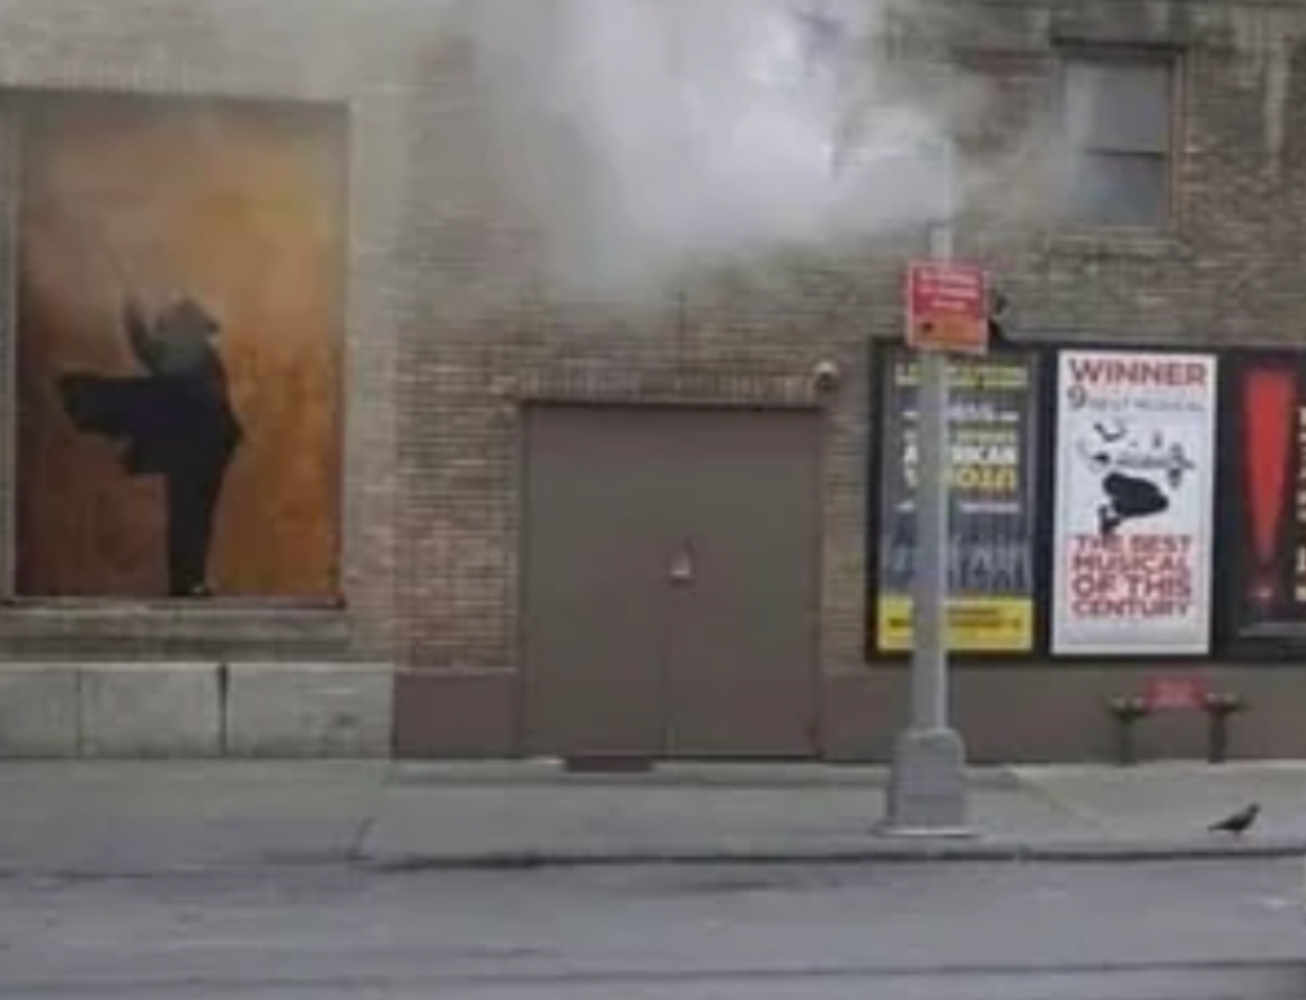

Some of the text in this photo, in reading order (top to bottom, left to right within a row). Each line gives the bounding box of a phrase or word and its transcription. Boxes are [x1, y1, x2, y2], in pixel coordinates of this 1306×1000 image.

[1067, 359, 1207, 386] WINNER
[1074, 534, 1192, 552] THE BEST
[1073, 554, 1191, 574] MUSICAL
[1071, 574, 1192, 598] OF THIS
[1071, 599, 1188, 617] CENTURY
